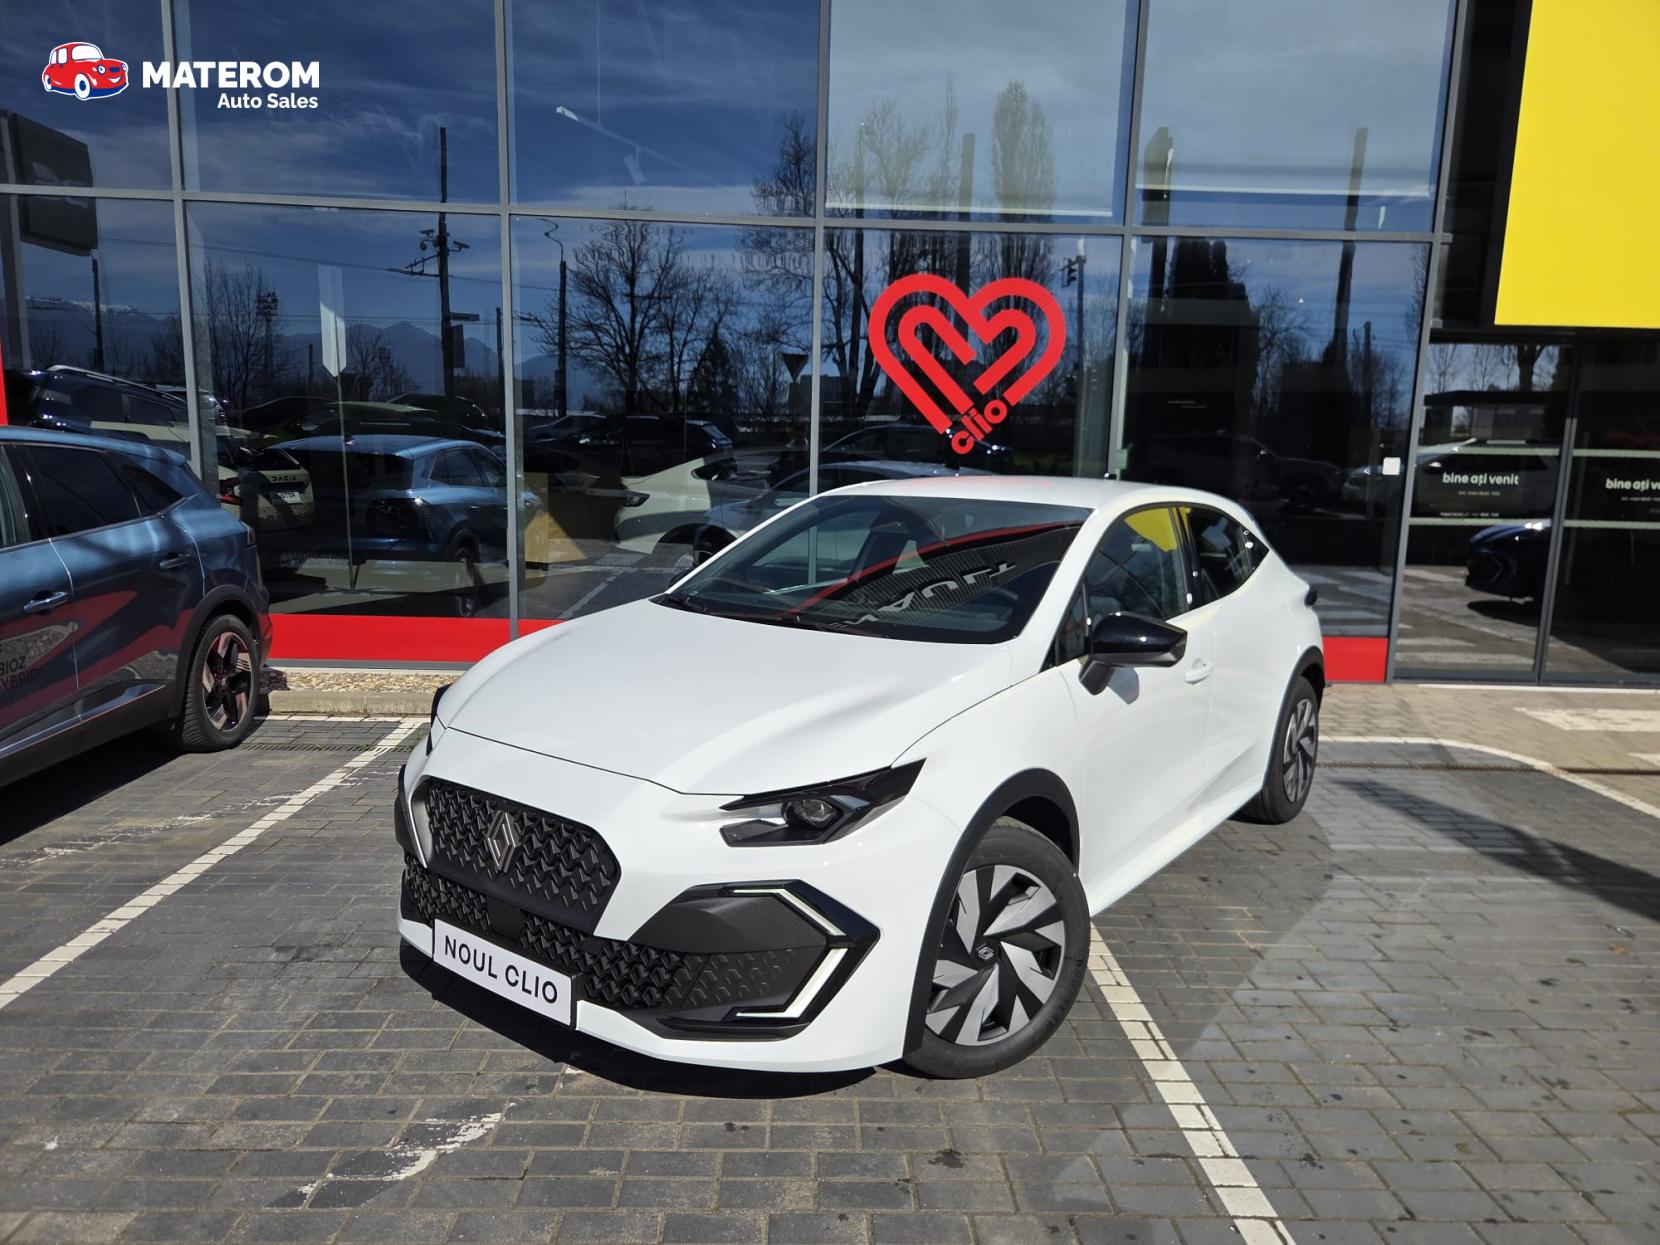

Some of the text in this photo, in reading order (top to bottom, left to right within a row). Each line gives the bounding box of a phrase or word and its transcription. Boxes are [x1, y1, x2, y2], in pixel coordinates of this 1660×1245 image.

[951, 399, 1008, 455] clio
[1442, 471, 1469, 485] bine
[1489, 472, 1520, 486] venit
[1605, 477, 1632, 490] bine
[444, 935, 558, 1004] NOUL CLIO
